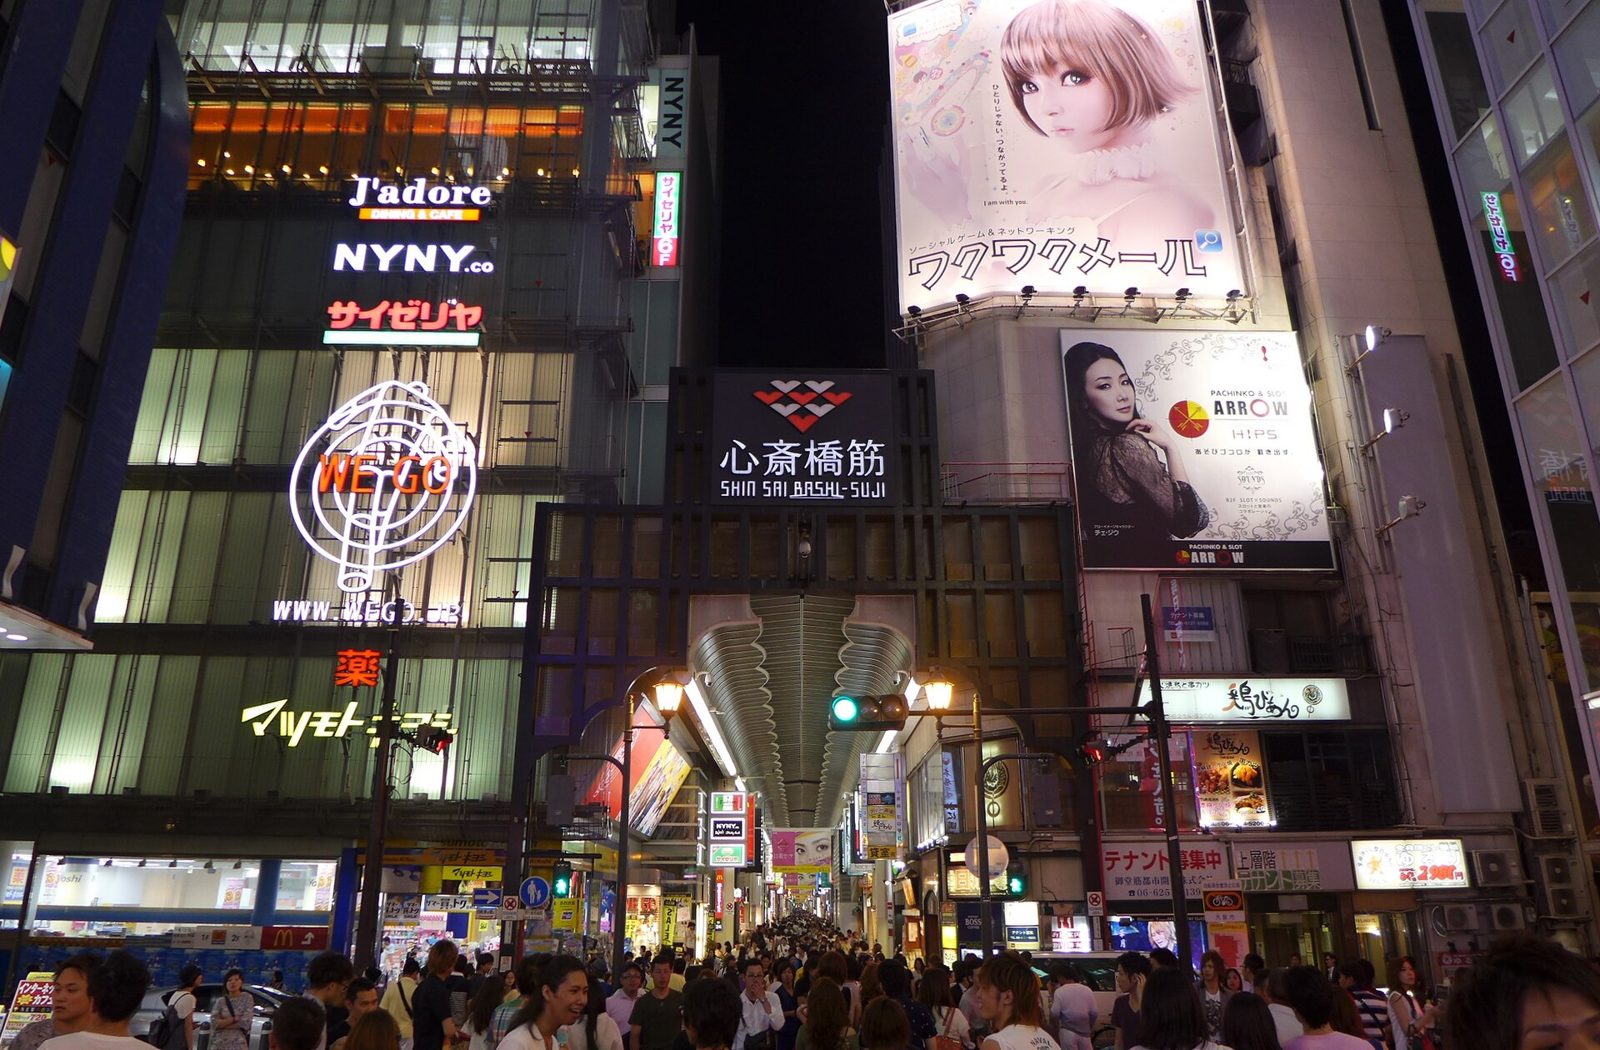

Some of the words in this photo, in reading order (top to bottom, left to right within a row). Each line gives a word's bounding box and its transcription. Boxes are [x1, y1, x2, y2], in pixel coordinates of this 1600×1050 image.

[662, 77, 684, 149] NYNY
[349, 177, 491, 206] J'adore
[371, 209, 415, 220] DINING
[418, 209, 428, 220] &
[430, 209, 463, 220] CAFE
[657, 238, 673, 266] 6F
[909, 231, 986, 255] ソーシャルゲーム
[999, 227, 1076, 236] ネットワーキング
[333, 243, 494, 273] NYNY.co
[908, 237, 1208, 291] ワクワクメール
[327, 300, 483, 331] サイゼリヤ
[1214, 399, 1288, 417] ARROW
[719, 439, 885, 477] 心斎橋筋
[721, 481, 756, 497] SHIN
[763, 481, 787, 498] SAI
[1190, 550, 1245, 564] ARROW
[335, 649, 382, 687] 薬
[1237, 850, 1276, 870] 上層階
[964, 918, 983, 927] BOSS
